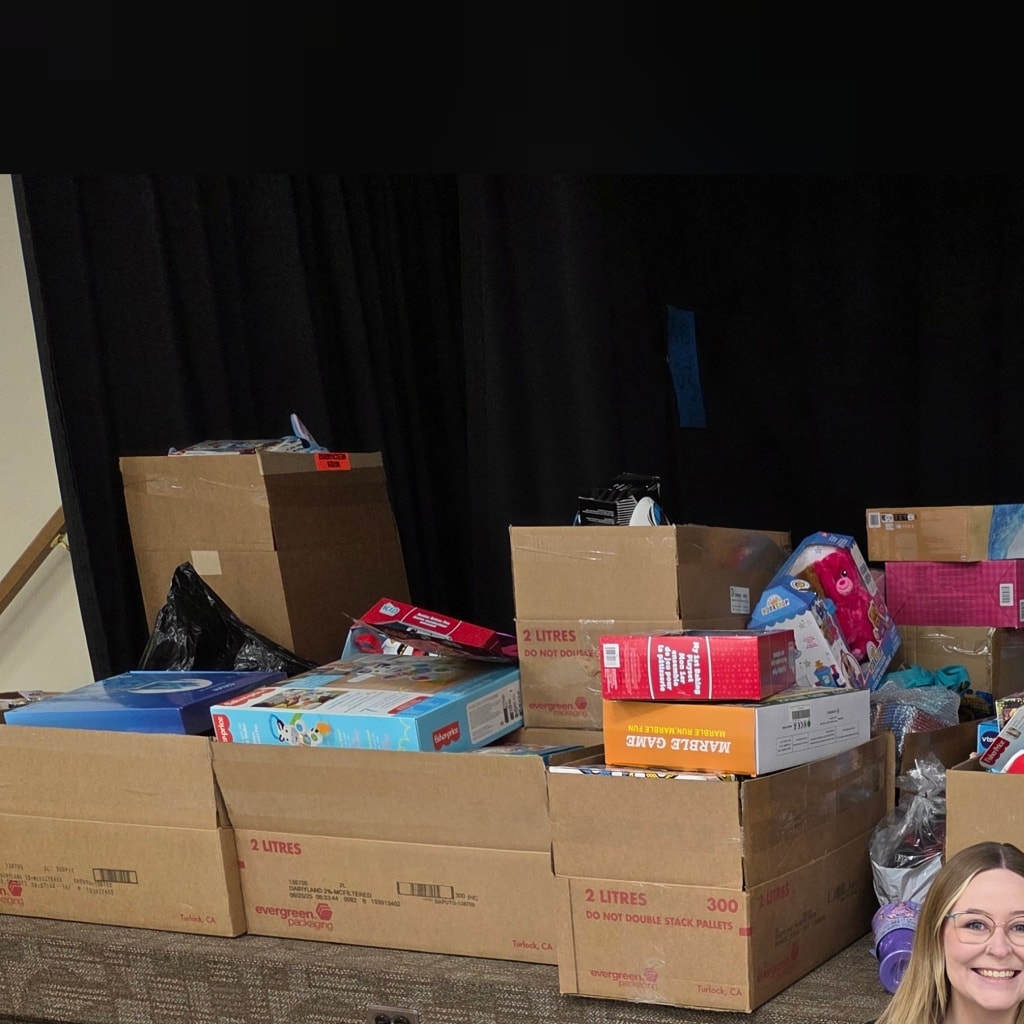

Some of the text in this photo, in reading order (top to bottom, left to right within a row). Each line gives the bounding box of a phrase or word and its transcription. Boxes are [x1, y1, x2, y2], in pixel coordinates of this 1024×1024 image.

[523, 629, 576, 642] 2 LITRES
[628, 724, 726, 738] MARBLE FUN
[626, 735, 732, 753] MARBLE GAME
[250, 839, 301, 855] 2 LITRES
[584, 889, 739, 913] 2 LITRES 300
[255, 905, 314, 920] evergreen
[206, 915, 216, 924] CA
[288, 919, 334, 931] packaging
[586, 911, 733, 931] DO NOT DOUBLE STACK PALLETS
[512, 940, 553, 950] Turlock, CA
[591, 969, 643, 981] evergreen
[697, 985, 742, 997] Turlock, CA
